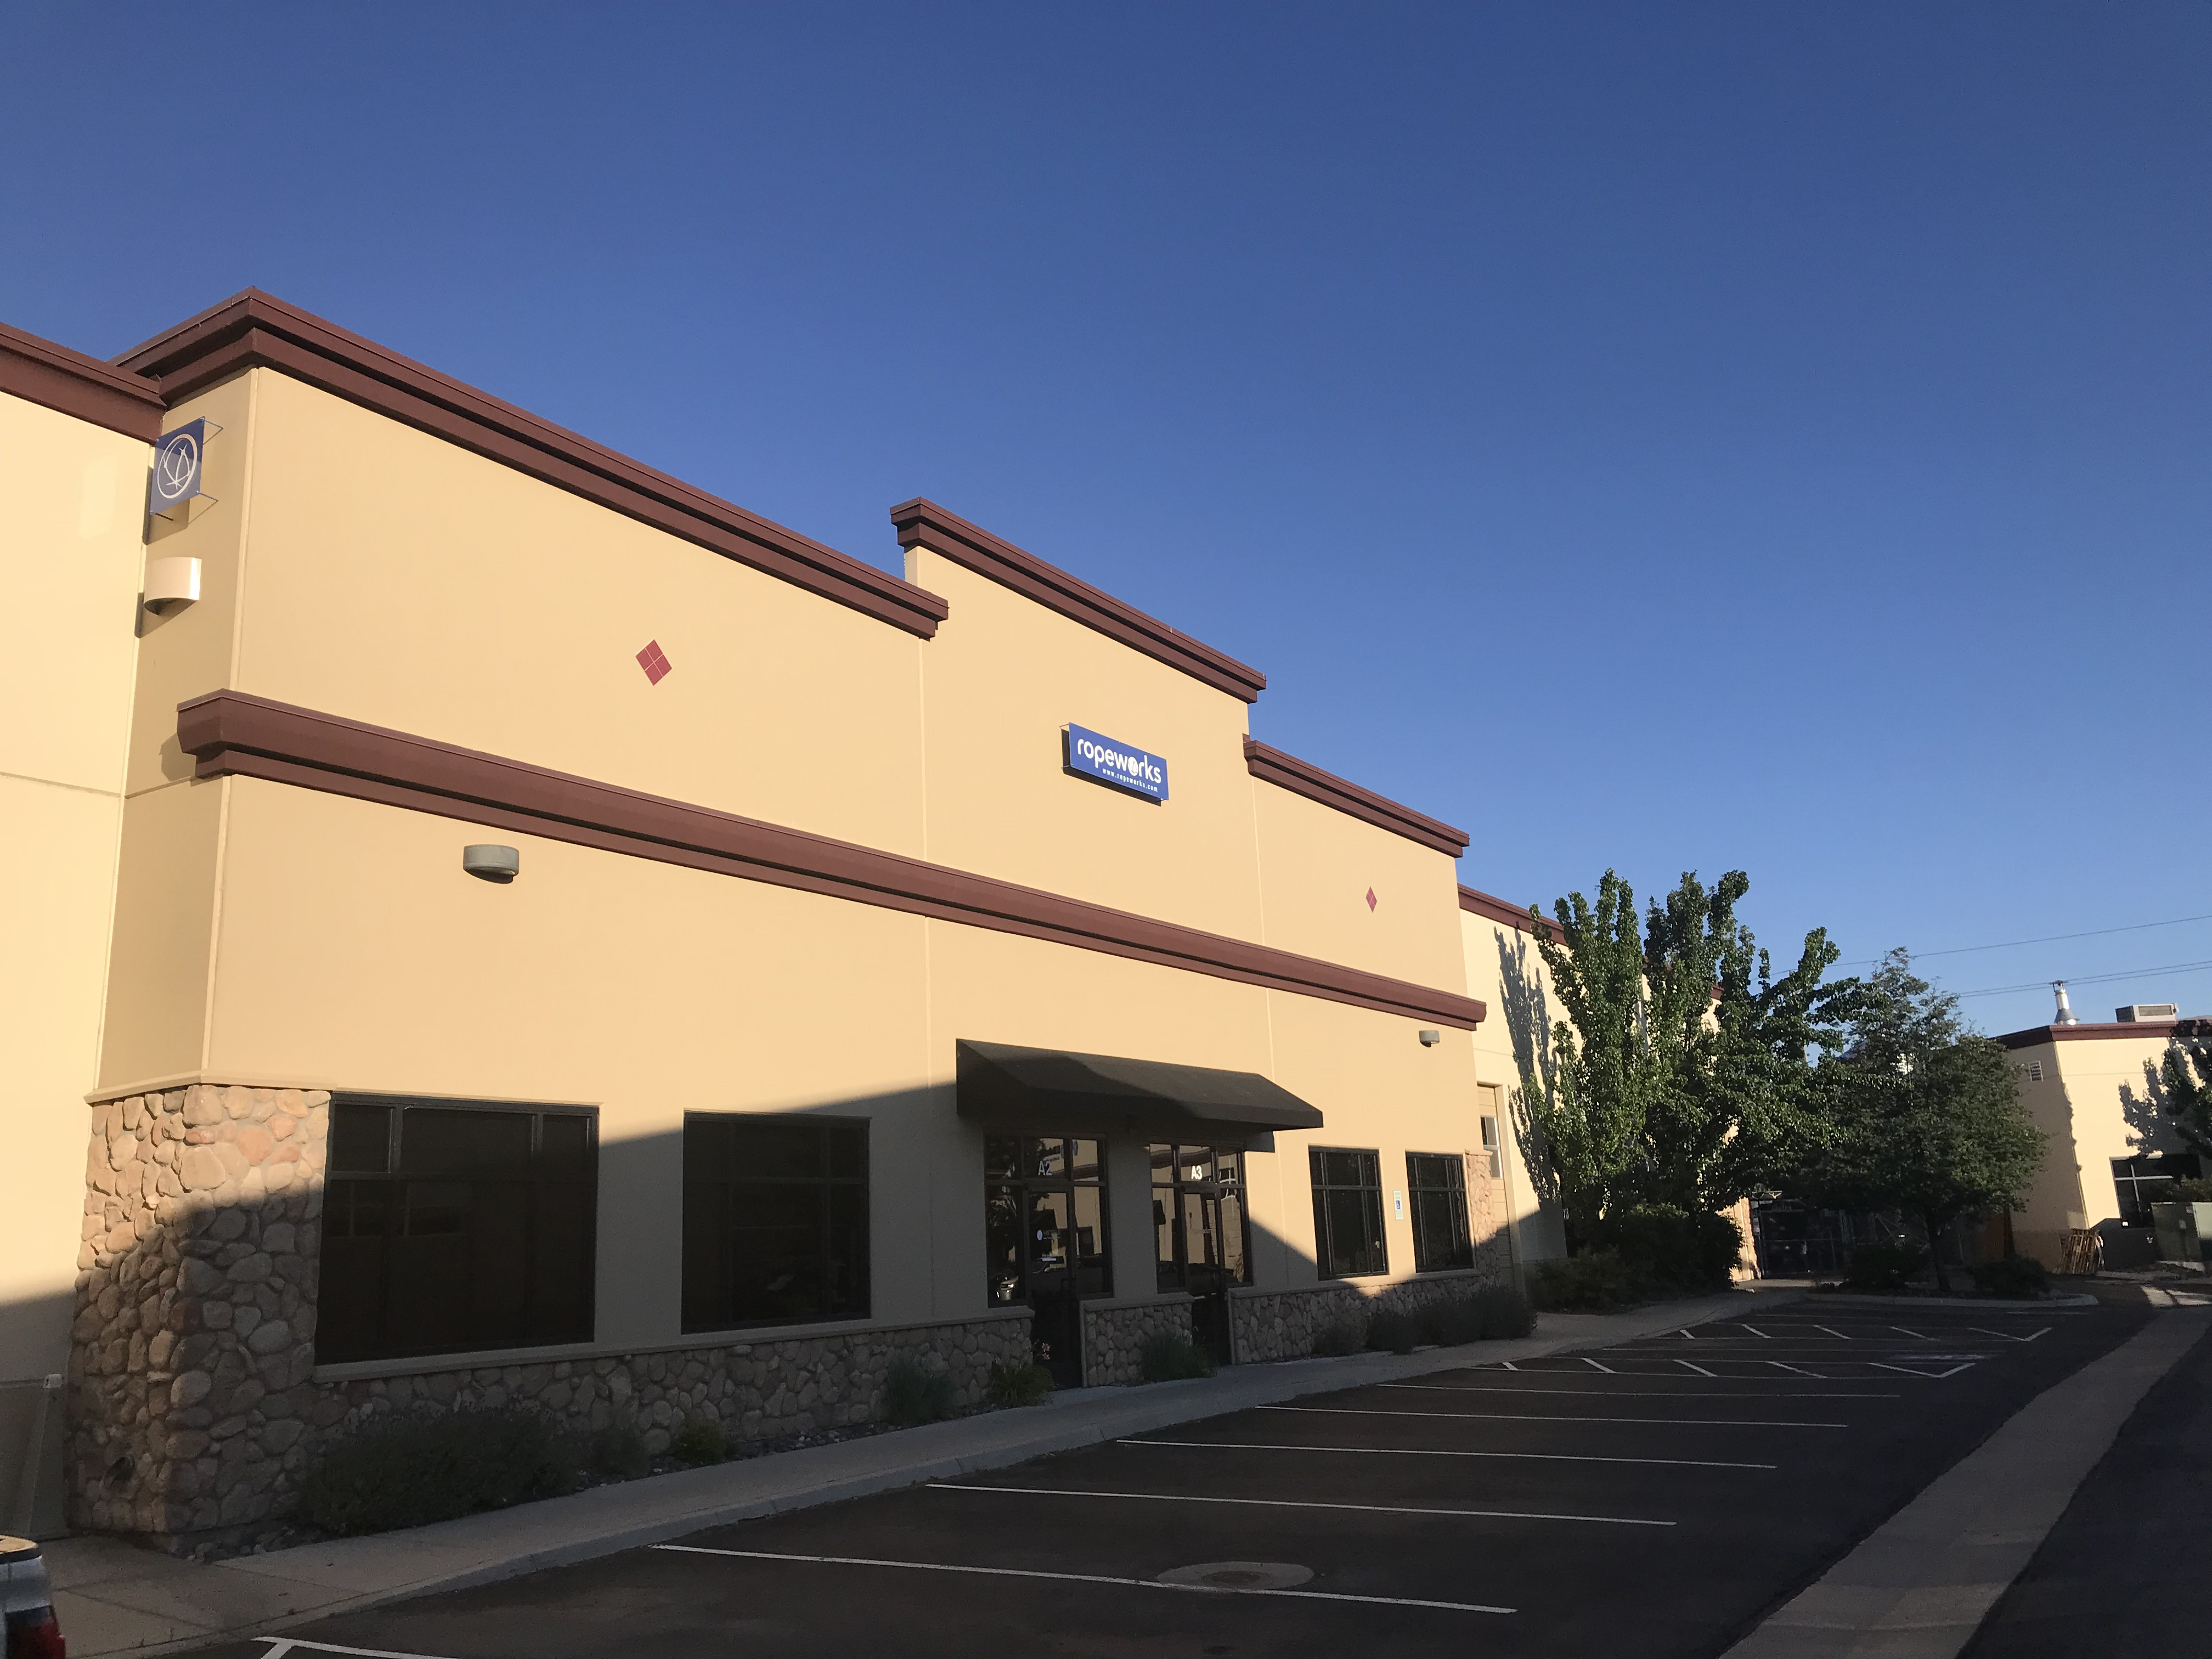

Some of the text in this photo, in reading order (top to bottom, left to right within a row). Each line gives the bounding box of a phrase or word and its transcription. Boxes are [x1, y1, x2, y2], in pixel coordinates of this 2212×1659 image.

[1077, 738, 1161, 783] ropeworks
[1102, 768, 1158, 793] www.ropeworks.com
[1038, 1160, 1052, 1176] A2
[1191, 1165, 1203, 1180] A3
